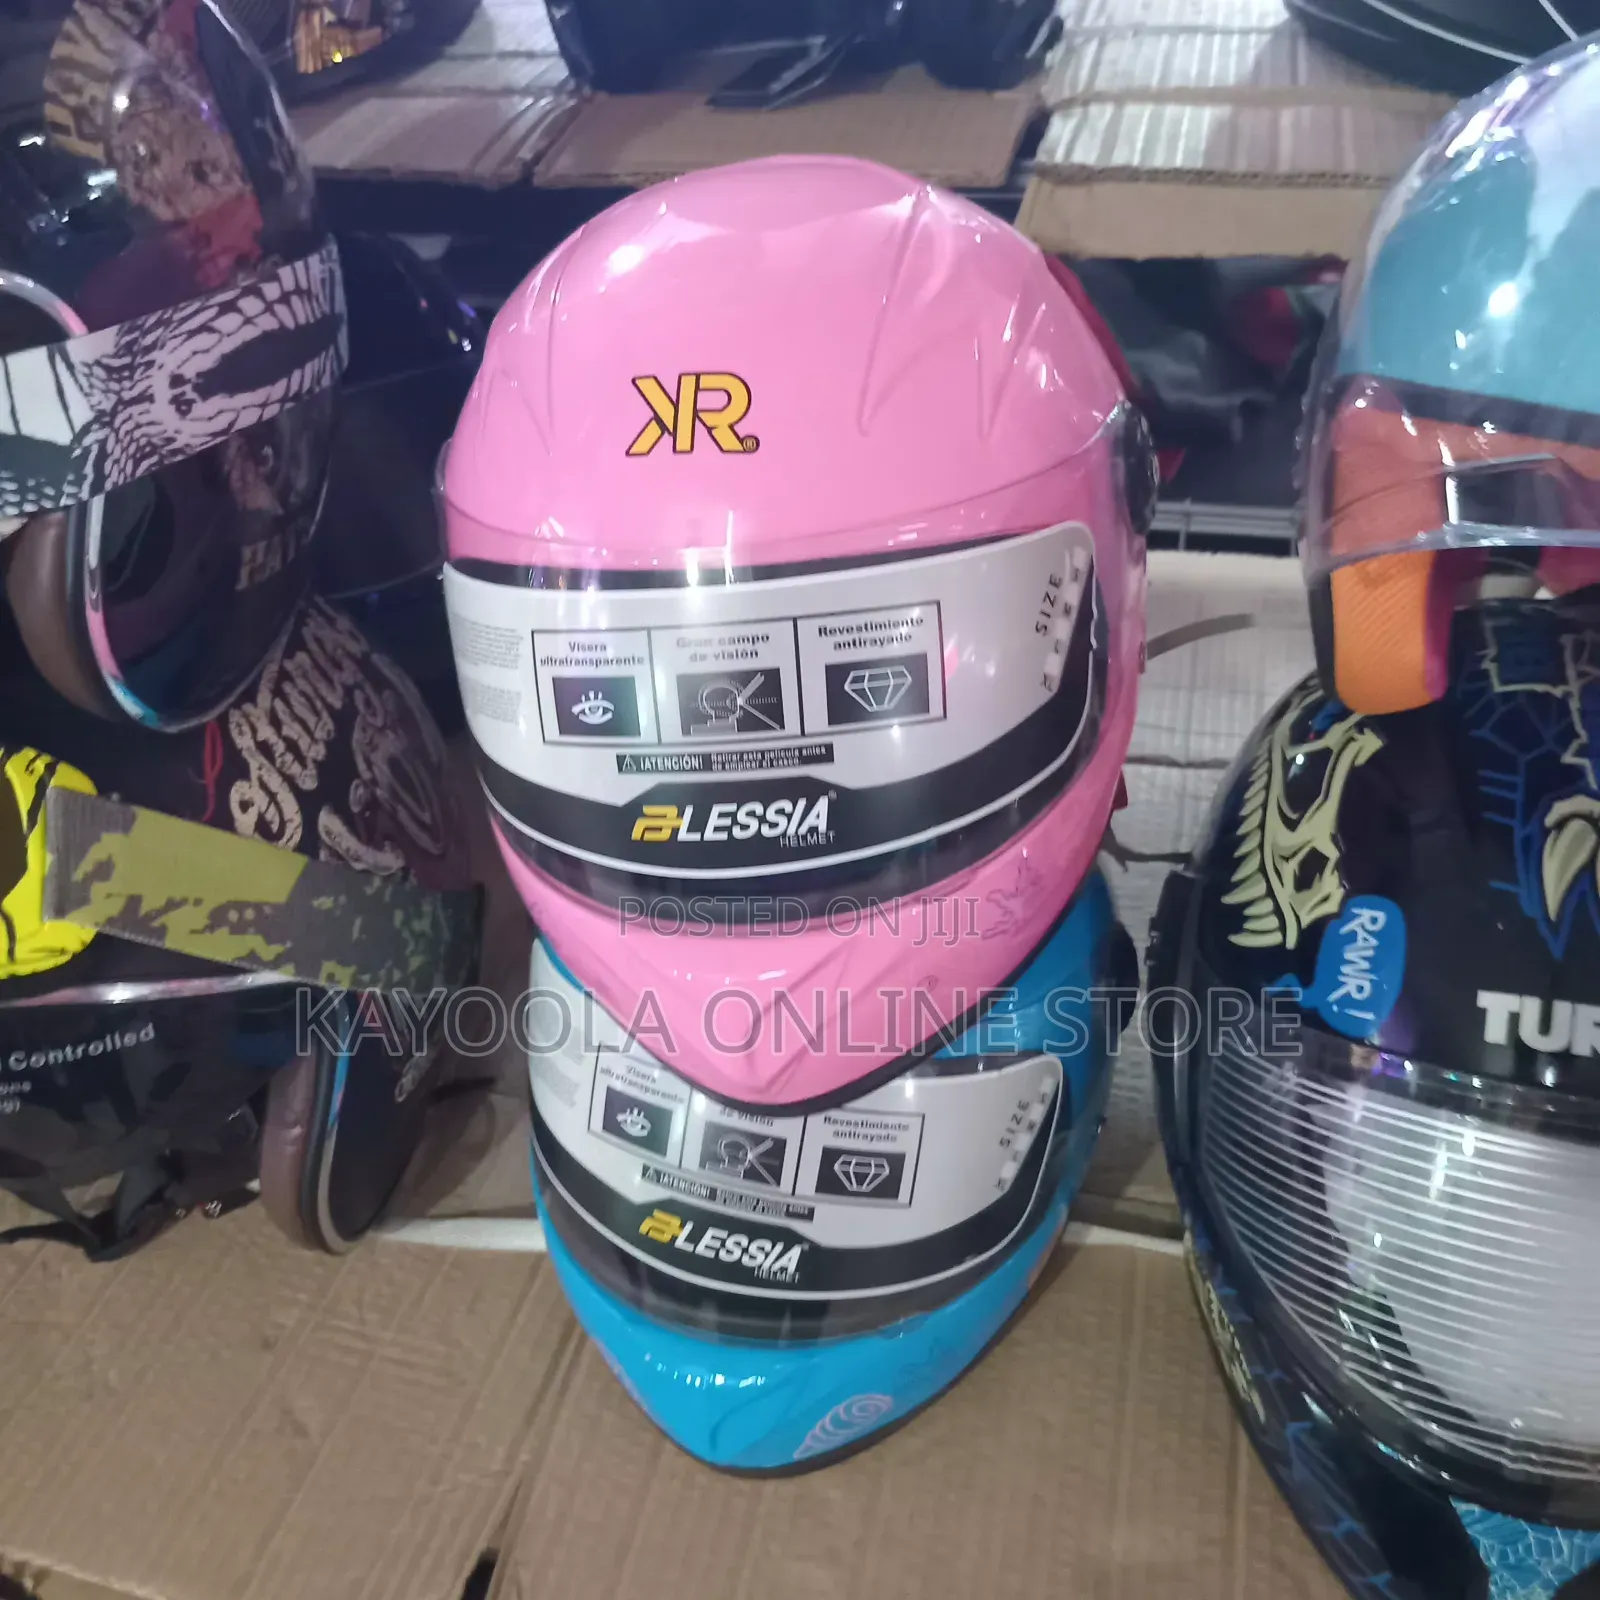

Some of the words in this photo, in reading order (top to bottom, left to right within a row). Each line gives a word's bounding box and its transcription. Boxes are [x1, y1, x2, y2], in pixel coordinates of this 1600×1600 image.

[1034, 573, 1062, 636] SIZE
[817, 617, 924, 638] Revestimiento
[568, 641, 608, 653] Visera
[718, 633, 770, 646] campo
[833, 632, 912, 650] antirayado
[540, 654, 646, 668] ultratransparente
[780, 832, 835, 848] HELMET
[8, 1022, 155, 1071] Controlled
[999, 1100, 1030, 1147] SIZE
